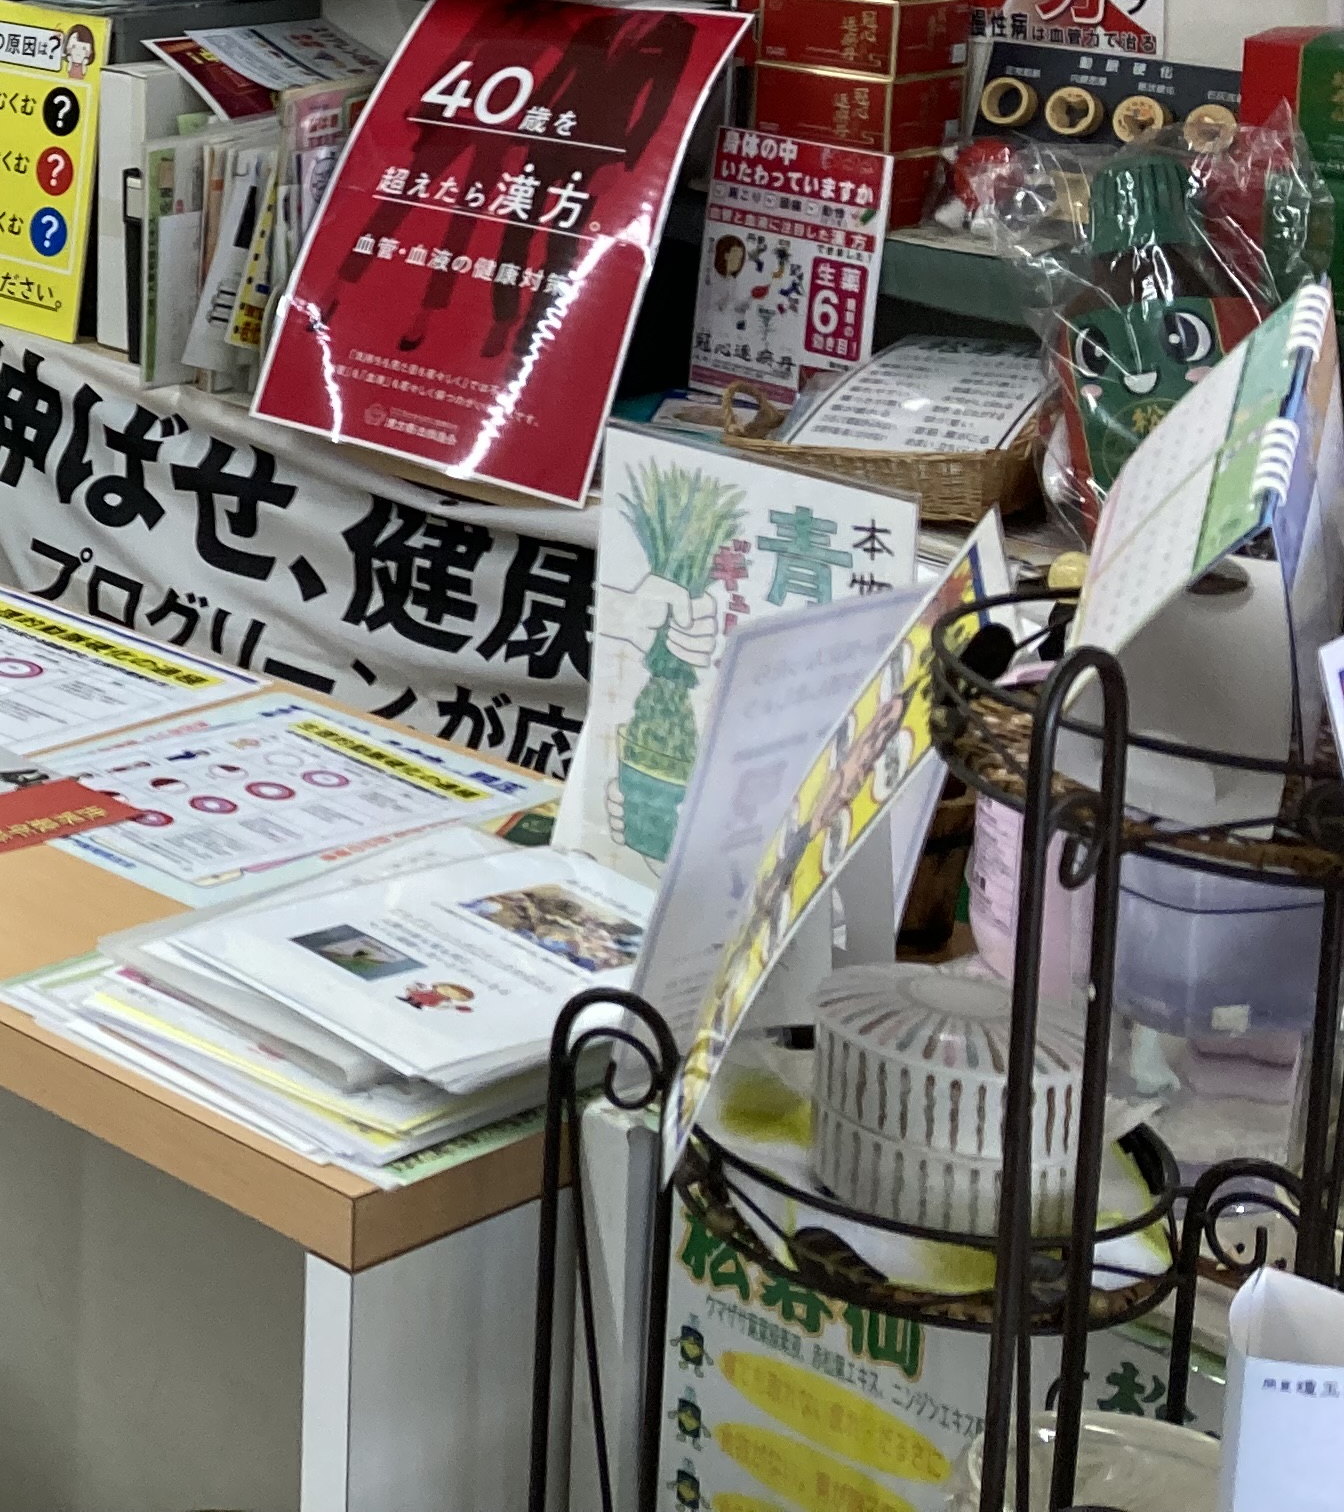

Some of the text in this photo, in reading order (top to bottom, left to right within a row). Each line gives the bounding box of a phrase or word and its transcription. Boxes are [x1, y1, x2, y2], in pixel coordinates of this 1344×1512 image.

[723, 130, 798, 165] 身体の中
[721, 160, 874, 205] いたわっていますか
[813, 289, 839, 334] 6
